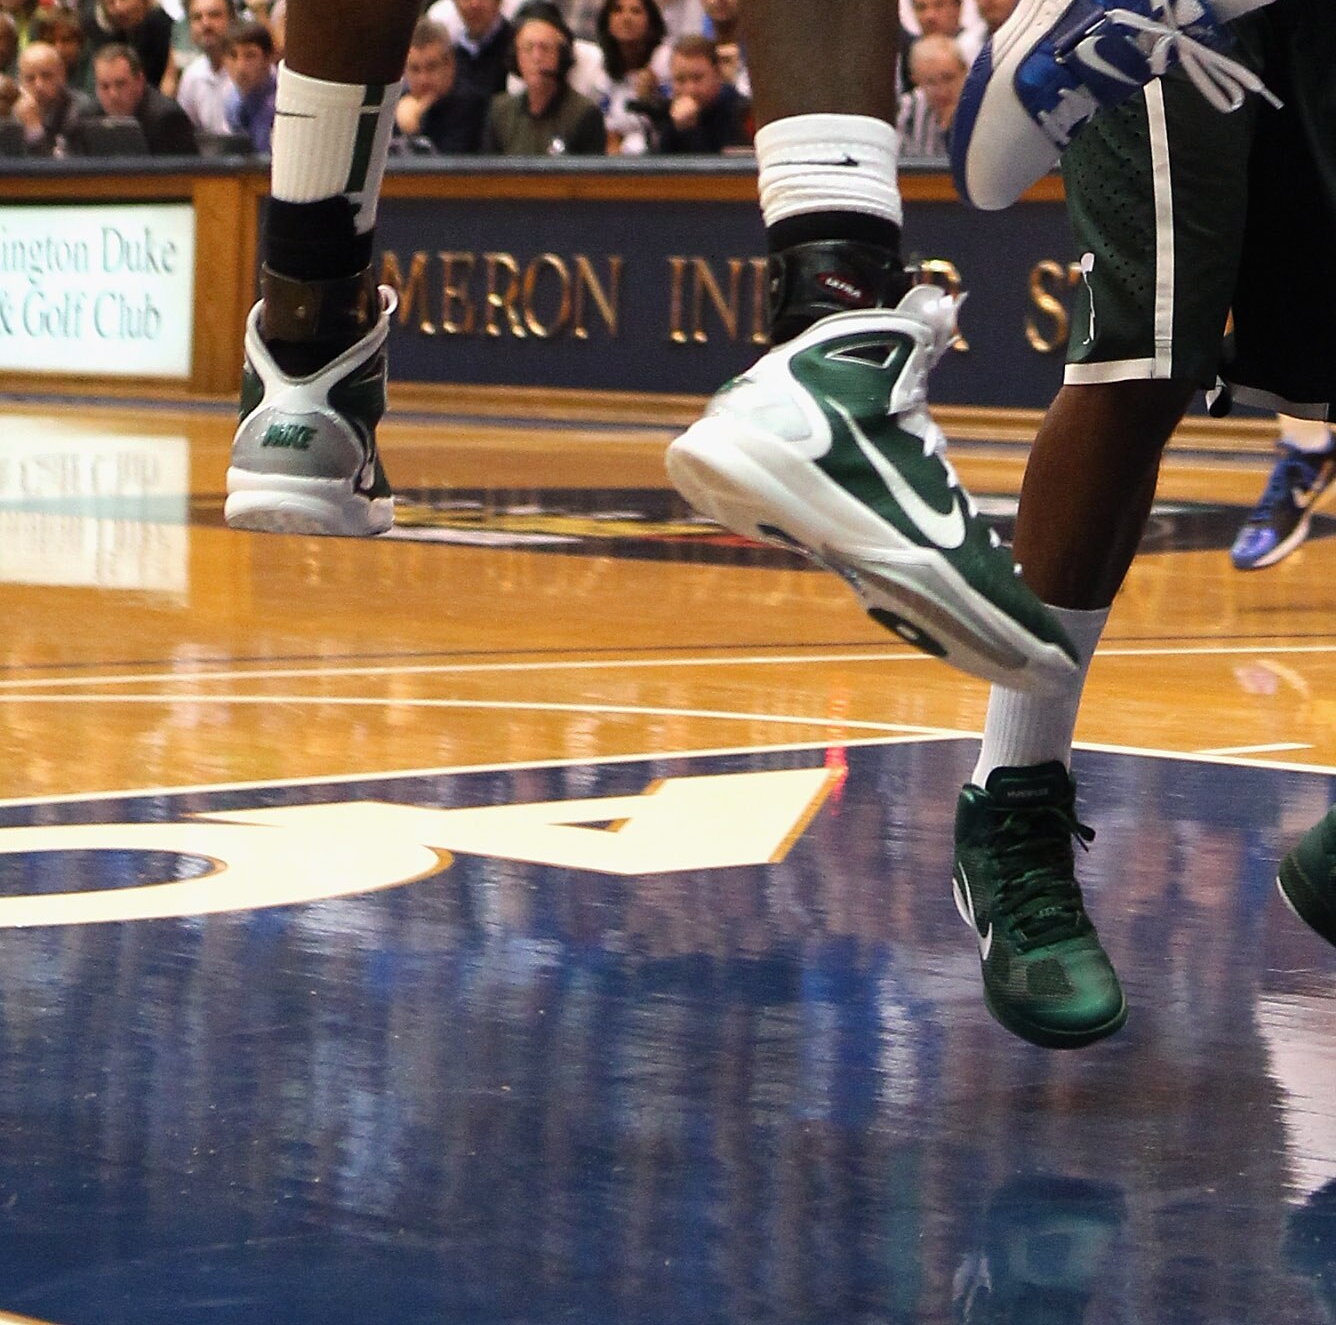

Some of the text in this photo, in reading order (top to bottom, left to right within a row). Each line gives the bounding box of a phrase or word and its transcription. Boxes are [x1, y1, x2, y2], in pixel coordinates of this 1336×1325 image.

[0, 225, 176, 283] ington Duke
[23, 286, 87, 338] Golf
[93, 289, 162, 340] Club
[380, 250, 624, 339] MERON
[262, 423, 318, 451] NIKE
